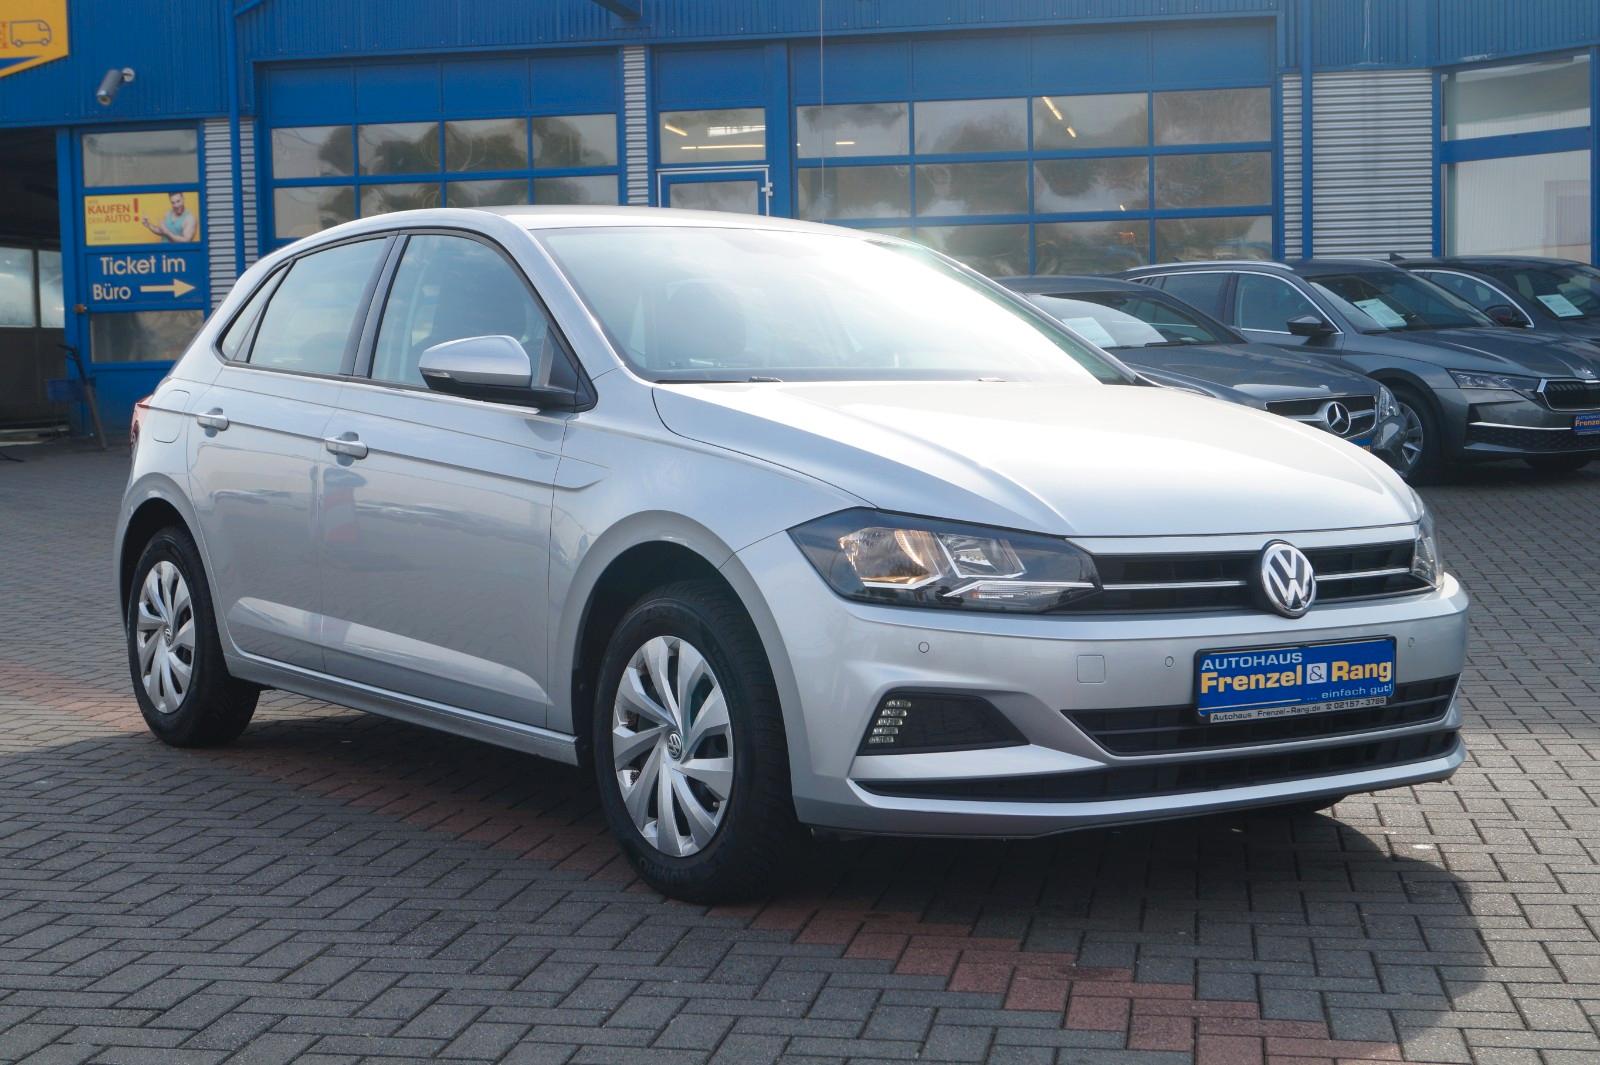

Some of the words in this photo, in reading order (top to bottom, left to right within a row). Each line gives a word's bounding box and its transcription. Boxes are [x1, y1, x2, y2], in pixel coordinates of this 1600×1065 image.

[87, 203, 130, 215] KAUFEN
[104, 213, 131, 224] AUTO
[100, 256, 156, 275] Ticket
[162, 255, 186, 273] im
[92, 283, 132, 301] Büro
[1263, 543, 1314, 611] VW
[1201, 652, 1303, 671] AUTOHAUS
[1200, 664, 1303, 694] Frenzel
[1308, 664, 1326, 683] &
[1331, 660, 1392, 682] Rang
[1321, 686, 1366, 699] einfach
[1370, 683, 1392, 695] gut!
[1212, 712, 1253, 721] Autohaus
